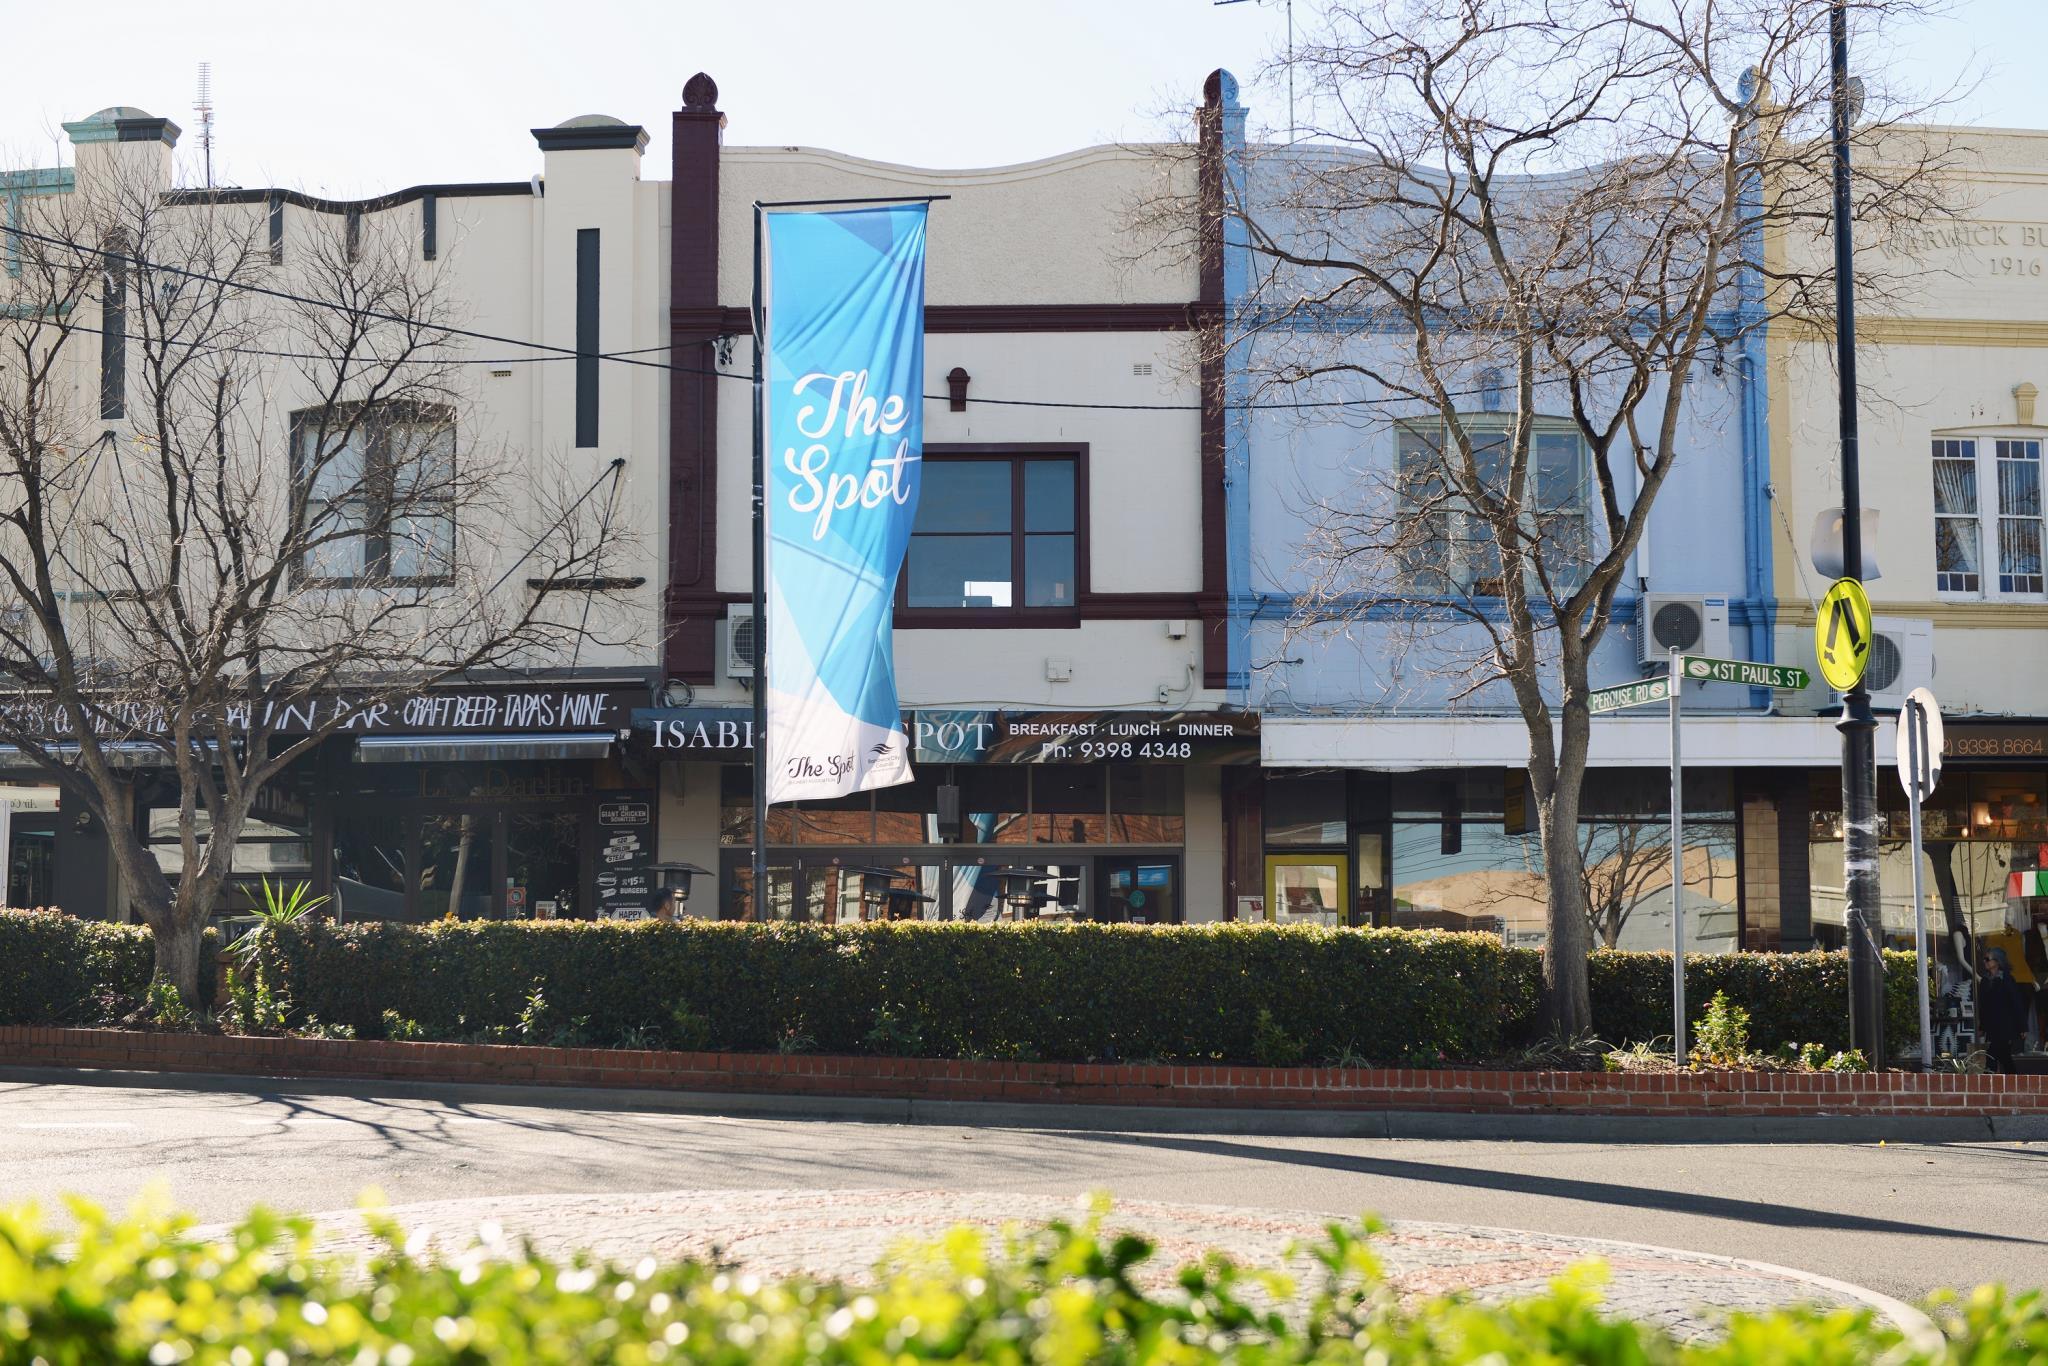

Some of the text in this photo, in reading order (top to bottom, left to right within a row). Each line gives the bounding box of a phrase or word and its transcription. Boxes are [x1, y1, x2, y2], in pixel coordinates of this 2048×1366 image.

[1990, 256, 2041, 277] 1916
[793, 369, 910, 438] The
[784, 437, 922, 541] Spot
[1720, 663, 1802, 688] ST PAULS ST
[404, 696, 457, 726] CRAFT
[453, 695, 498, 727] BEER
[503, 693, 554, 727] TAPAS
[560, 692, 609, 726] WINE
[1592, 684, 1648, 710] PEROUSE RD
[901, 721, 994, 751] POT
[1009, 723, 1233, 737] BREAKFAST LUNCH DINNER
[1042, 742, 1191, 758] Ph: 9398 4348
[1958, 739, 1999, 754] 9398
[2003, 739, 2043, 754] 8664
[788, 752, 855, 784] The Spot
[619, 910, 642, 919] HAPPY
